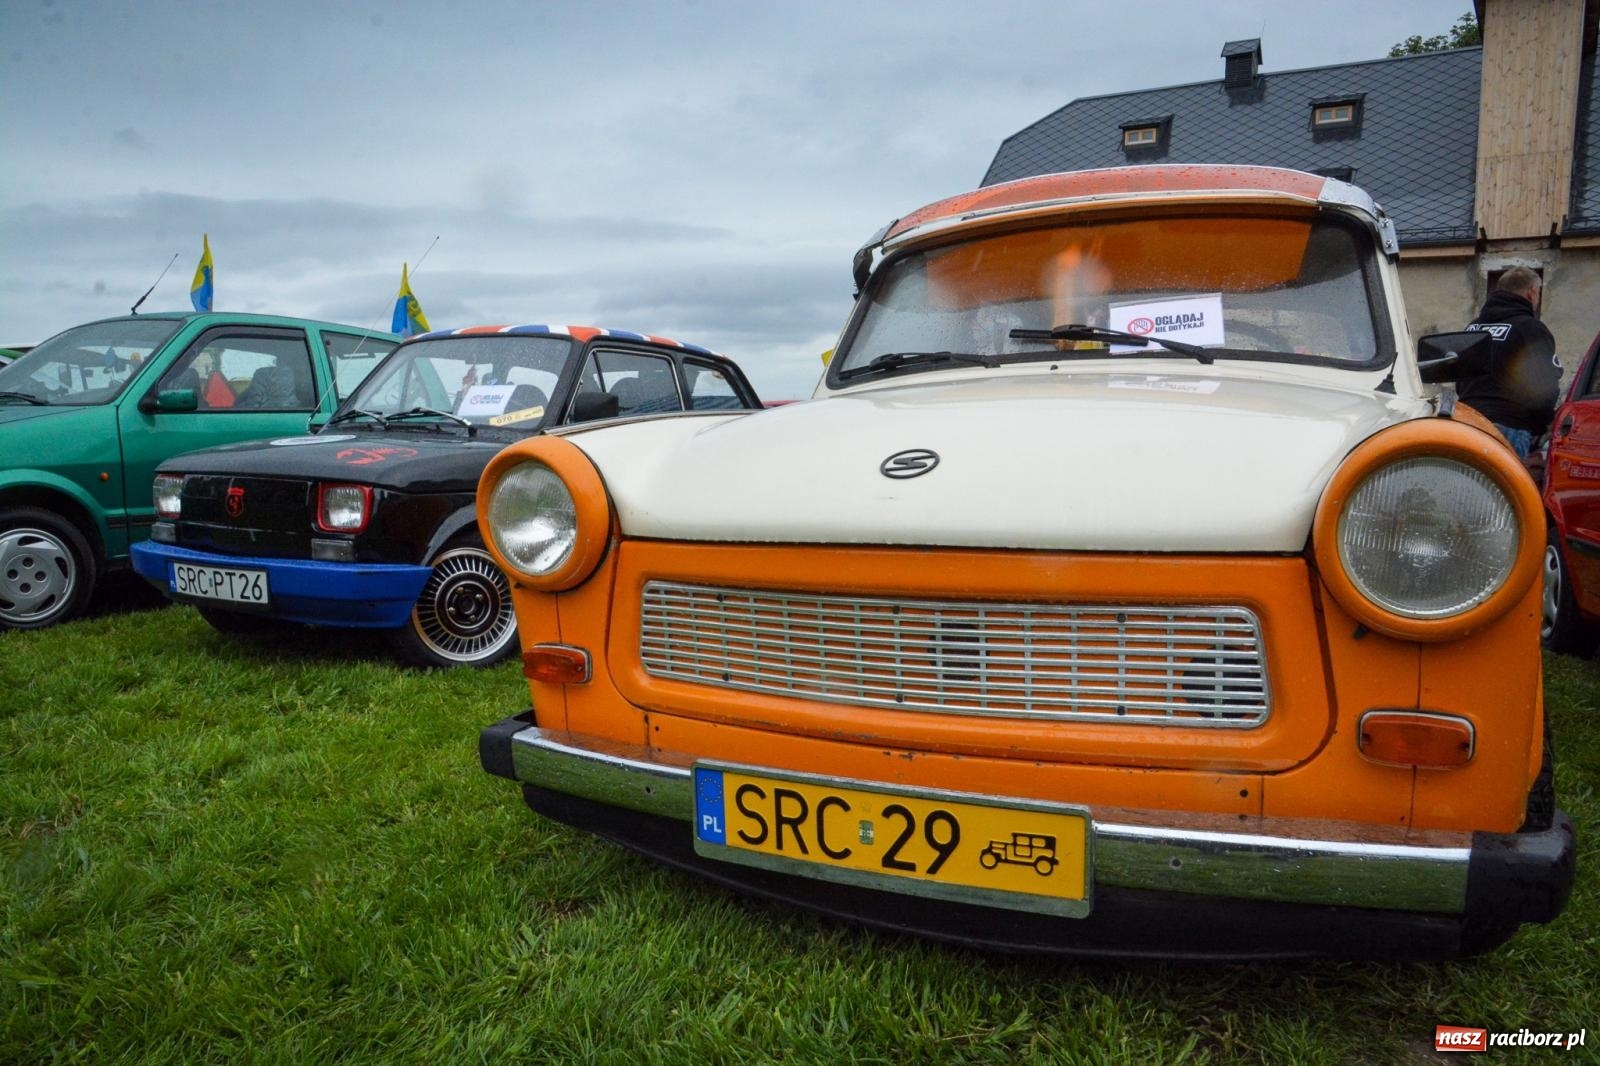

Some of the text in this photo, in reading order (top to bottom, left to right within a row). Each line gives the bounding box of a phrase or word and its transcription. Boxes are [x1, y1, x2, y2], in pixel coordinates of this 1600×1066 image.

[1155, 312, 1204, 327] OGLĄDAJ
[1155, 322, 1205, 333] NIE DOTYKAJ!
[177, 566, 263, 601] SRC PT26
[702, 814, 722, 834] PL
[735, 783, 961, 875] SRC 29
